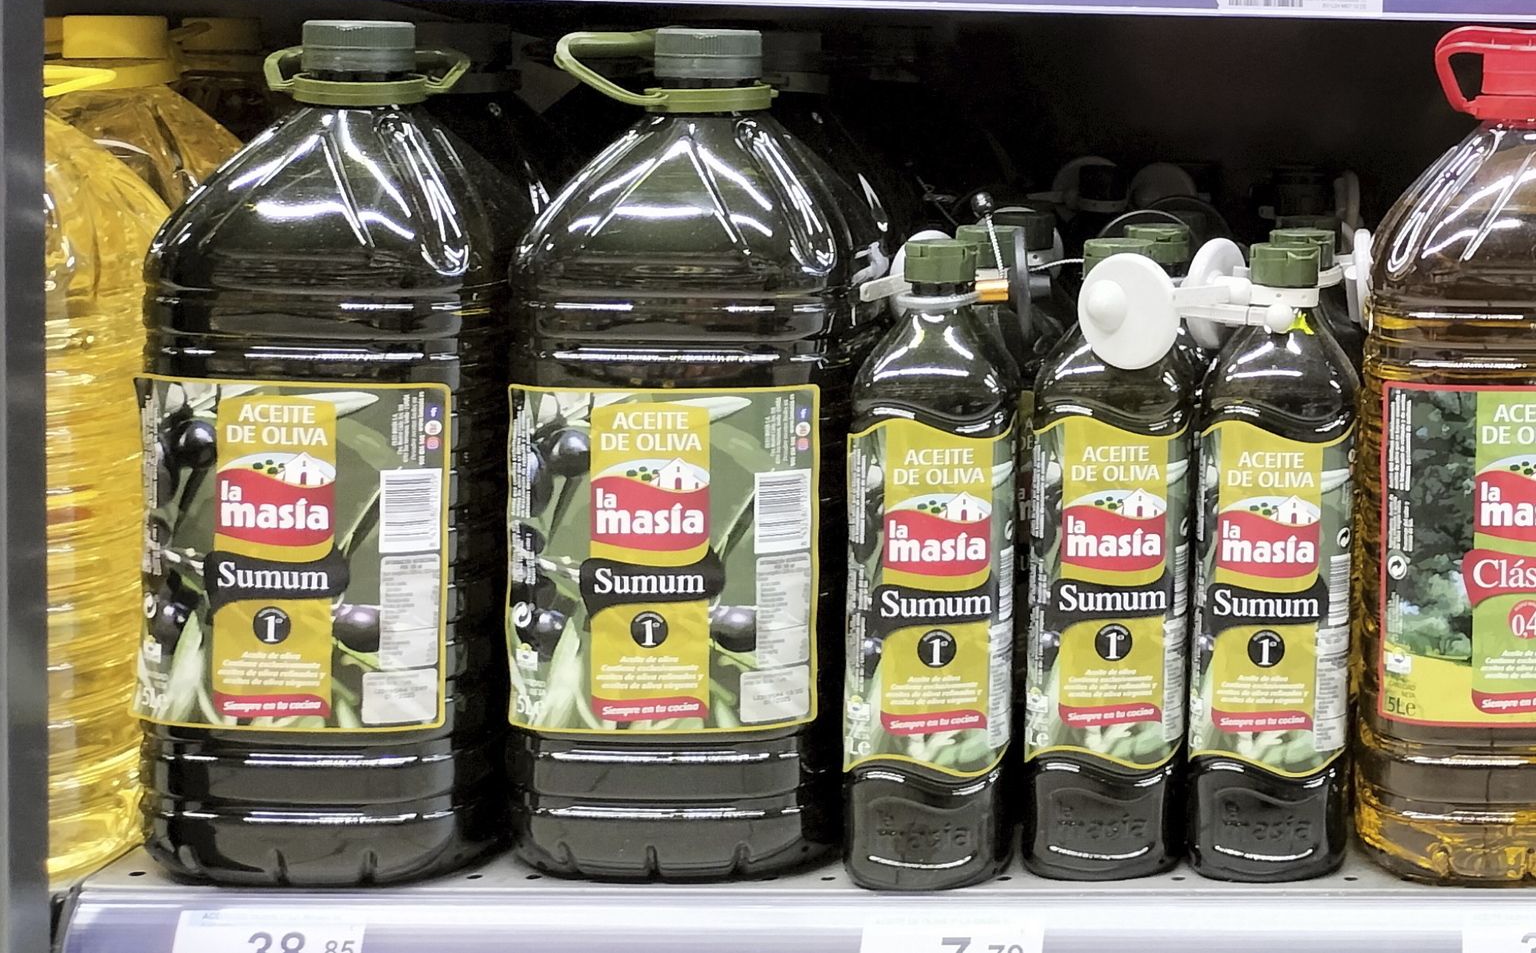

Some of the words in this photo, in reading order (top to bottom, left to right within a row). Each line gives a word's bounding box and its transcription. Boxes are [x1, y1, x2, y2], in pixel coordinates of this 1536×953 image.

[238, 403, 316, 423] ACEITE
[227, 424, 257, 443] DE
[261, 425, 329, 447] OLIVA
[1082, 446, 1150, 462] ACEITE
[1071, 464, 1099, 480] DE
[1103, 464, 1161, 481] OLIVA
[221, 480, 242, 501] la
[596, 487, 617, 508] la
[1480, 481, 1500, 502] la
[221, 497, 330, 531] masía
[596, 502, 705, 535] masía
[1066, 514, 1085, 535] la
[889, 520, 908, 539] la
[1222, 519, 1240, 540] la
[889, 532, 987, 562] masía
[1066, 528, 1161, 557] masía
[1222, 534, 1315, 564] masía
[217, 561, 330, 590] Sumum
[593, 568, 706, 594] Sumum
[880, 591, 992, 617] Sumum
[1058, 584, 1167, 611] Sumum
[1212, 589, 1320, 618] Sumum
